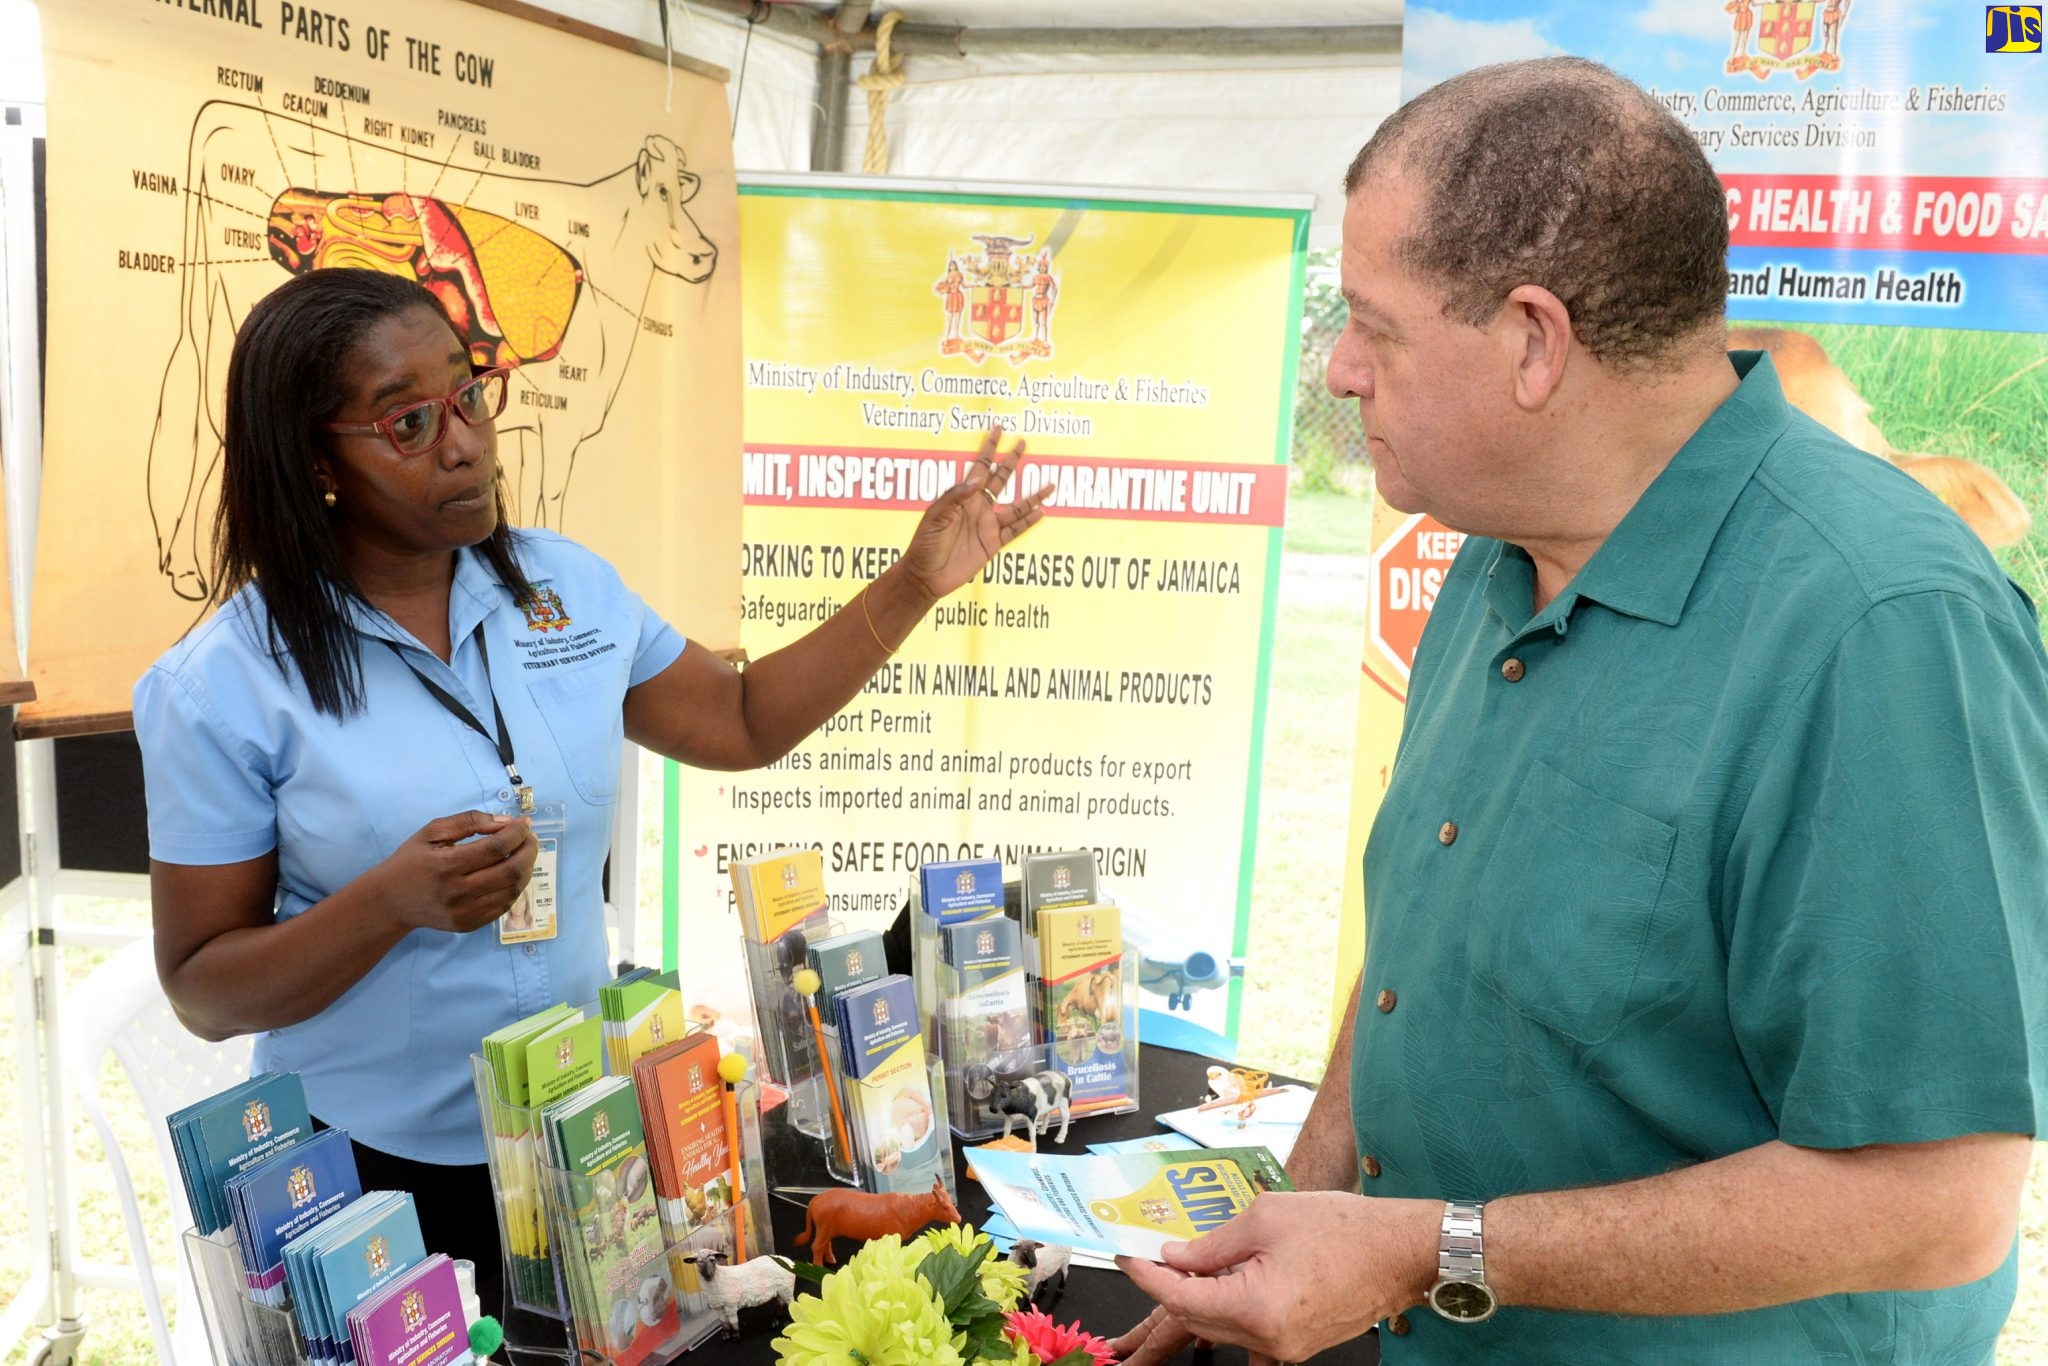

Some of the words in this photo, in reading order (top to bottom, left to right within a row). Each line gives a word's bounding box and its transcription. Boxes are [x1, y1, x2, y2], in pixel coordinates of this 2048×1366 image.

[281, 1, 351, 52] PARTS
[366, 26, 390, 62] OF
[405, 36, 441, 76] THE
[455, 51, 494, 89] COW
[217, 65, 263, 94] RECTUM
[314, 75, 370, 106] DEODENUM
[282, 92, 328, 119] CEACUM
[1704, 87, 1796, 115] Commerce,
[1802, 86, 1898, 117] Agriculture
[1905, 87, 1921, 112] &
[1926, 86, 2006, 112] Fisheries
[363, 116, 393, 139] RIGHT
[400, 126, 435, 149] KIDNEY
[438, 109, 487, 136] PANCREAS
[1730, 123, 1799, 147] Services
[1805, 123, 1876, 147] Division
[473, 139, 496, 161] GALL
[501, 147, 541, 171] BLADDER
[132, 169, 178, 196] VAGINA
[221, 163, 255, 187] OVARY
[515, 201, 539, 219] LIVER
[1748, 188, 1872, 234] HEALTH
[1879, 190, 1903, 235] &
[1912, 190, 2002, 238] FOOD
[224, 227, 261, 251] UTERUS
[568, 219, 590, 238] LUNG
[118, 250, 175, 274] BLADDER
[1728, 266, 1771, 295] and
[1778, 266, 1866, 299] Human
[1876, 269, 1962, 303] Health
[559, 364, 588, 382] HEART
[749, 362, 817, 393] Ministry
[823, 365, 842, 388] of
[846, 366, 915, 397] Industry,
[921, 369, 1012, 399] Commerce,
[1017, 374, 1109, 403] Agriculture
[1114, 377, 1129, 401] &
[1135, 378, 1208, 405] Fisheries
[520, 390, 568, 411] RETICULUM
[862, 402, 945, 434] Veterinary
[950, 406, 1017, 432] Services
[1024, 408, 1091, 435] Division
[799, 454, 957, 502] INSPECTION
[1021, 463, 1188, 512] QUARANTINE
[1191, 470, 1256, 515] UNIT
[1417, 532, 1467, 559] KEE
[820, 546, 845, 579] TO
[983, 552, 1075, 588] DISEASES
[1082, 555, 1120, 589] OUT
[1127, 558, 1151, 591] OF
[1157, 559, 1240, 594] JAMAICA
[1390, 567, 1448, 611] DIS
[935, 600, 988, 631] public
[995, 602, 1050, 629] health
[514, 639, 536, 648] Ministry
[522, 658, 560, 670] VETERINARY
[559, 653, 589, 665] SERVICES
[588, 642, 617, 657] DIVISION
[560, 644, 570, 653] and
[570, 638, 597, 651] Fisheries
[909, 663, 926, 695] IN
[932, 664, 998, 697] ANIMAL
[1004, 666, 1041, 699] AND
[1046, 668, 1113, 702] ANIMAL
[1119, 671, 1212, 706] PRODUCTS
[820, 710, 863, 737] port
[870, 709, 932, 734] Permit
[819, 747, 892, 772] animals
[900, 748, 933, 772] and
[940, 749, 1002, 774] animal
[1009, 752, 1093, 779] products
[1100, 754, 1126, 778] for
[1132, 758, 1192, 784] export
[732, 785, 812, 814] Inspects
[819, 785, 902, 814] imported
[909, 787, 971, 810] animal
[978, 788, 1011, 811] and
[1018, 789, 1080, 814] animal
[1087, 792, 1175, 820] products.
[831, 841, 884, 873] SAFE
[892, 841, 949, 873] FOOD
[1079, 846, 1147, 877] RIGIN
[1067, 1061, 1116, 1076] Brucellosis
[1075, 1075, 1085, 1085] in
[1086, 1071, 1112, 1083] Cattle
[1166, 1167, 1240, 1232] AITS
